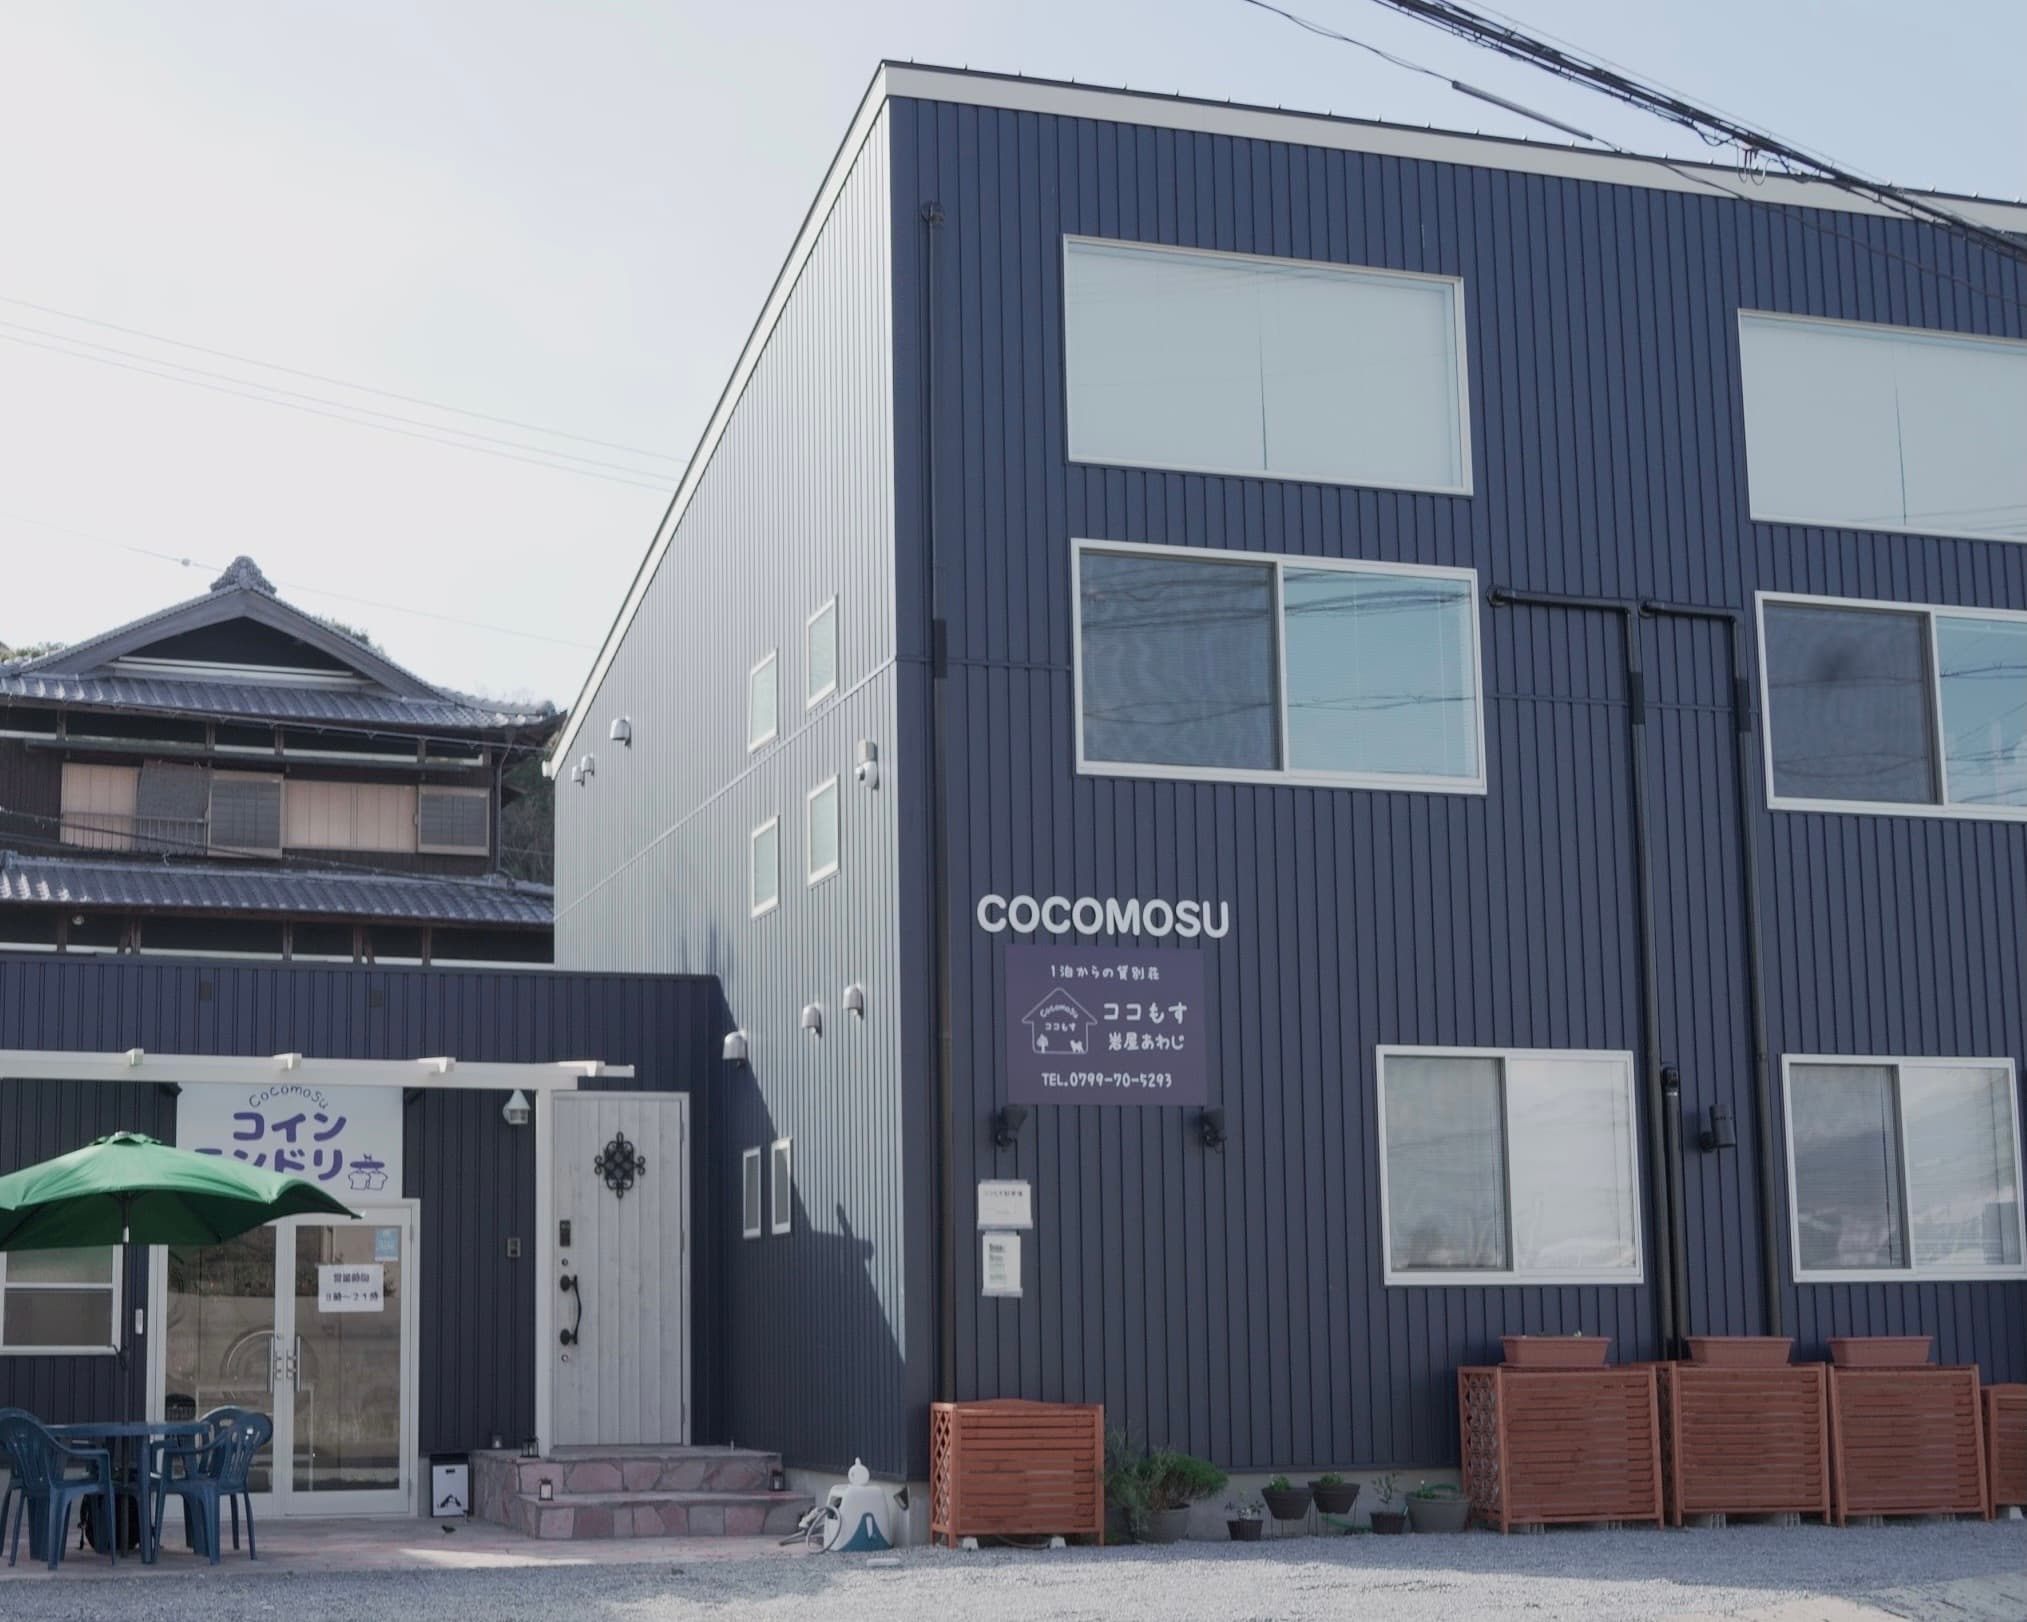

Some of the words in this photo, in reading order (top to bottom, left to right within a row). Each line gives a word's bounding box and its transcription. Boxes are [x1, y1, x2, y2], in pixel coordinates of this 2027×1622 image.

[976, 894, 1230, 938] COCOMOSU
[1103, 1002, 1187, 1024] ココもす
[1107, 1032, 1185, 1051] 岩屋あわじ
[233, 1112, 347, 1144] コイン
